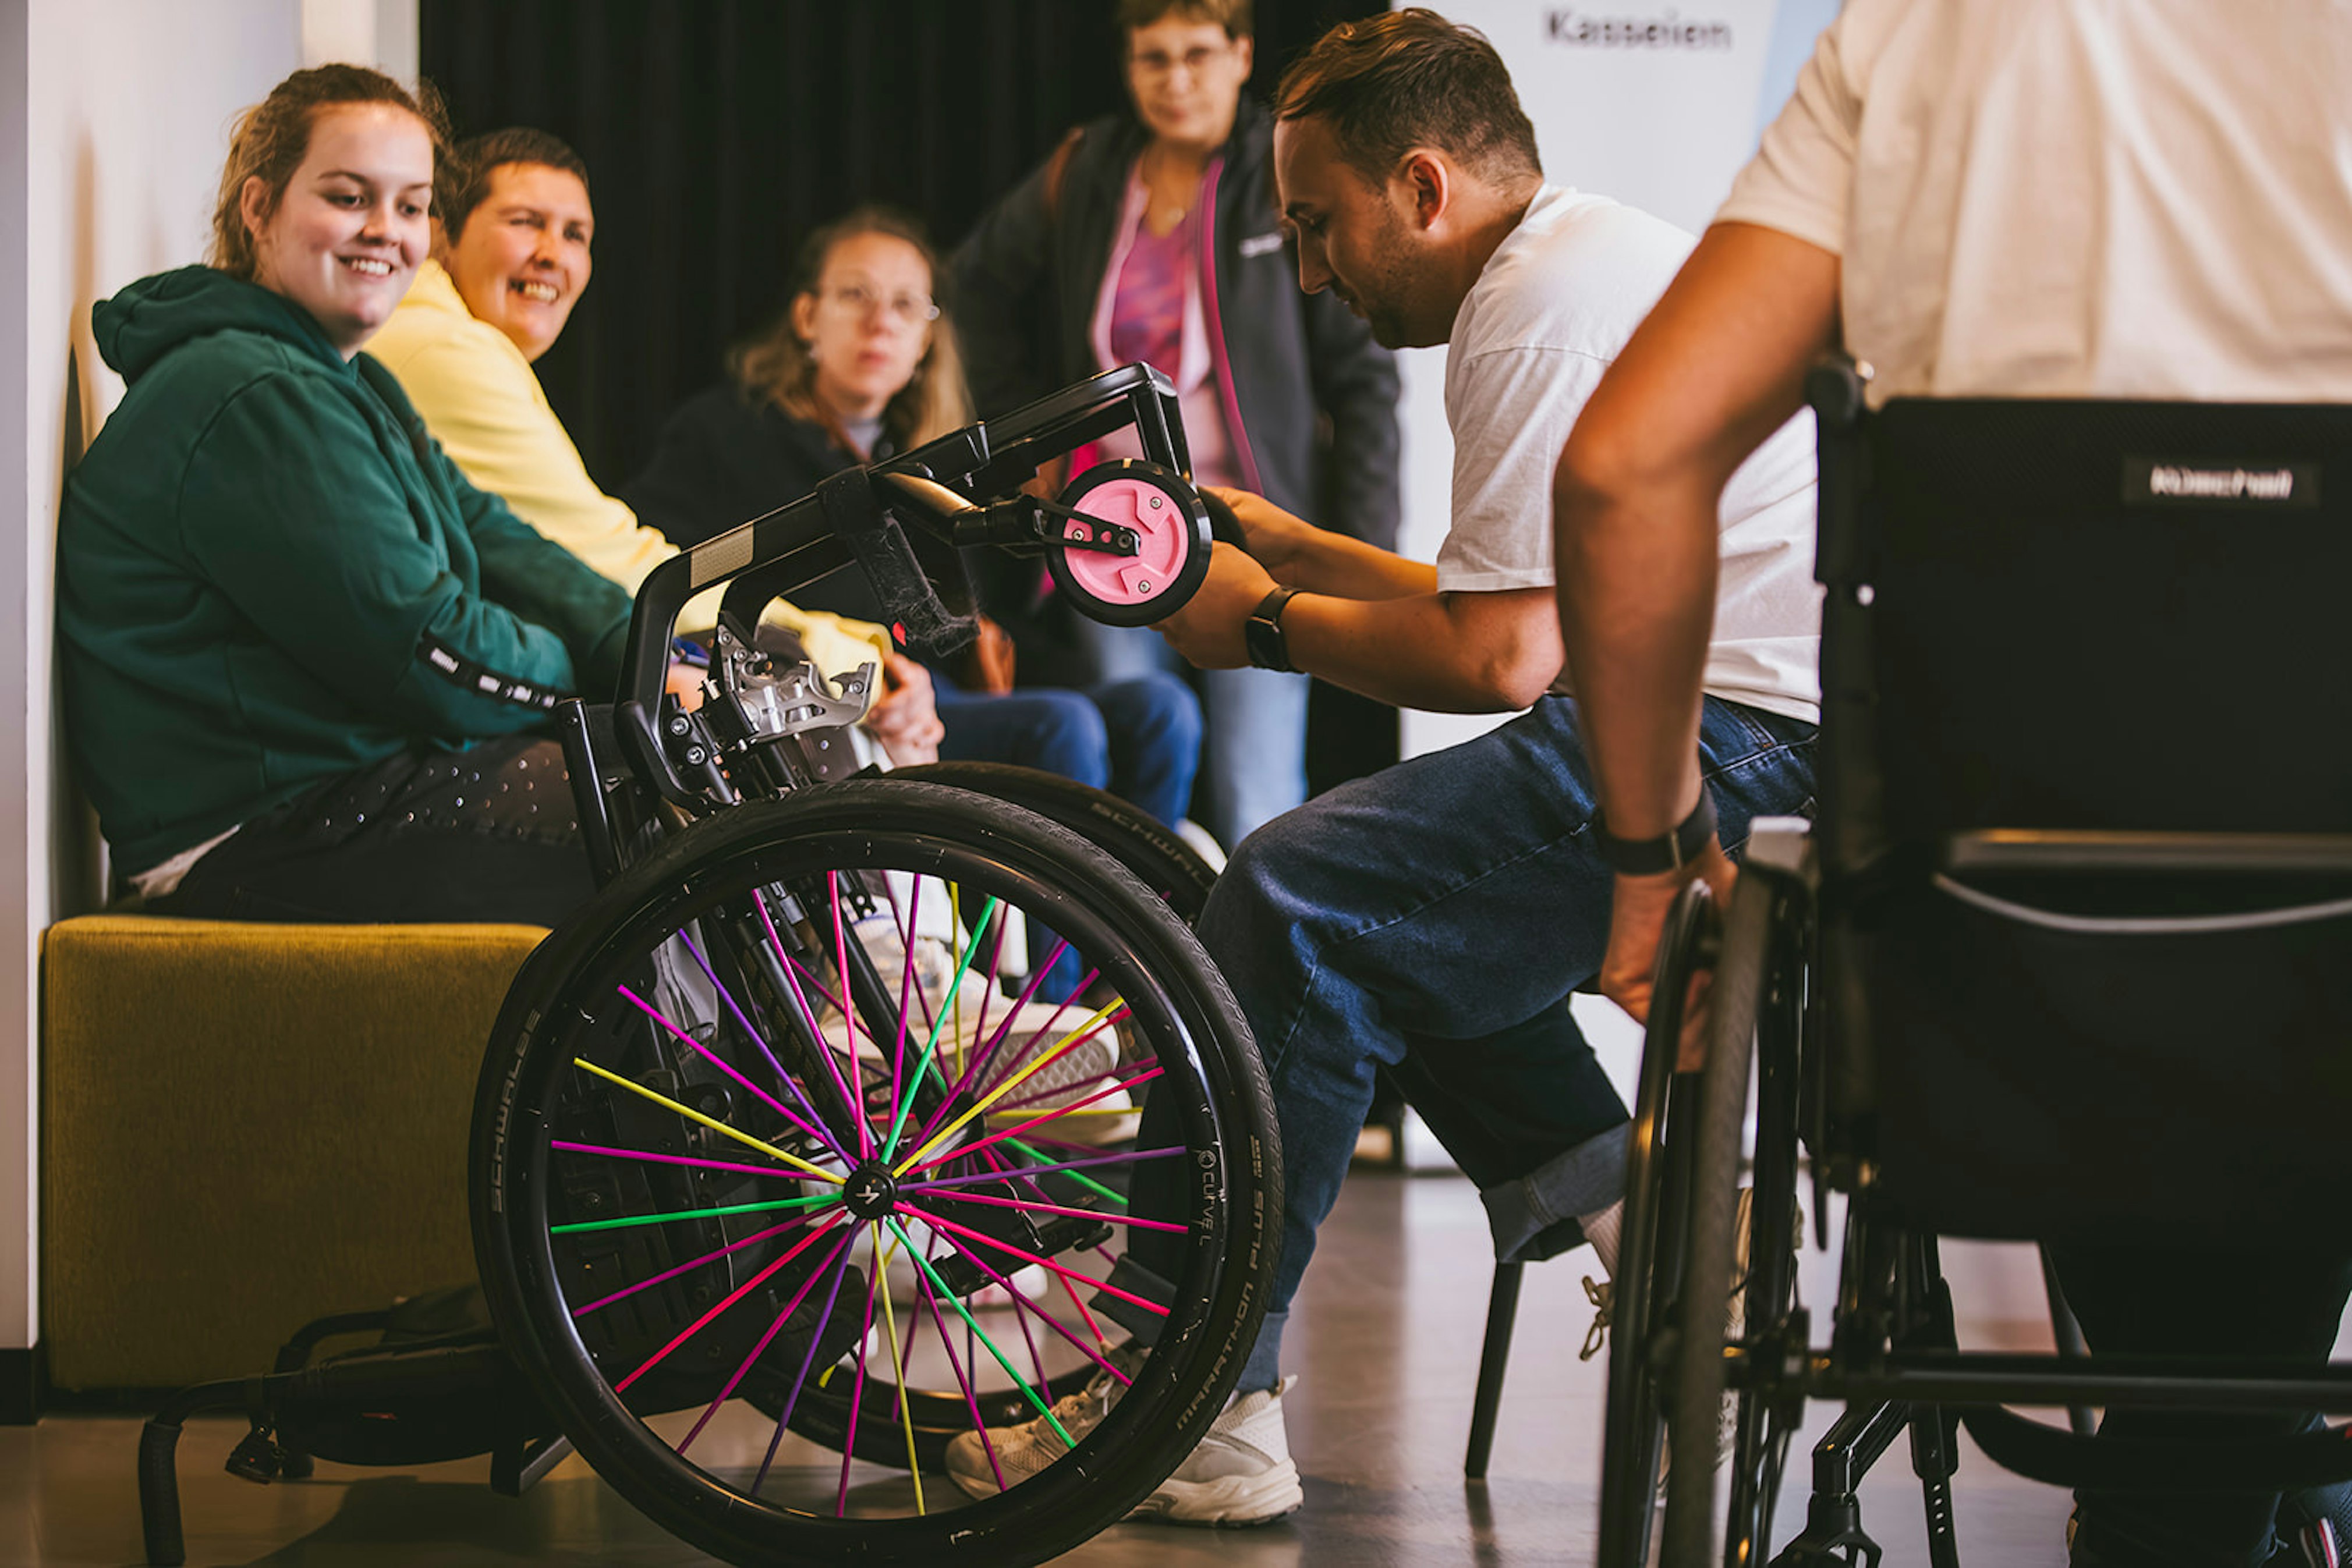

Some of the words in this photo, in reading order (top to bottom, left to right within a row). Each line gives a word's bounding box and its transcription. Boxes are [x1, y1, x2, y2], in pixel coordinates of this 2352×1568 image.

[1545, 9, 1731, 49] Kasseien
[1091, 802, 1210, 892] SCHWAL
[491, 1009, 541, 1213] SCHWALBE
[1176, 1280, 1254, 1431] MARATHON
[1249, 1189, 1264, 1271] PLUS
